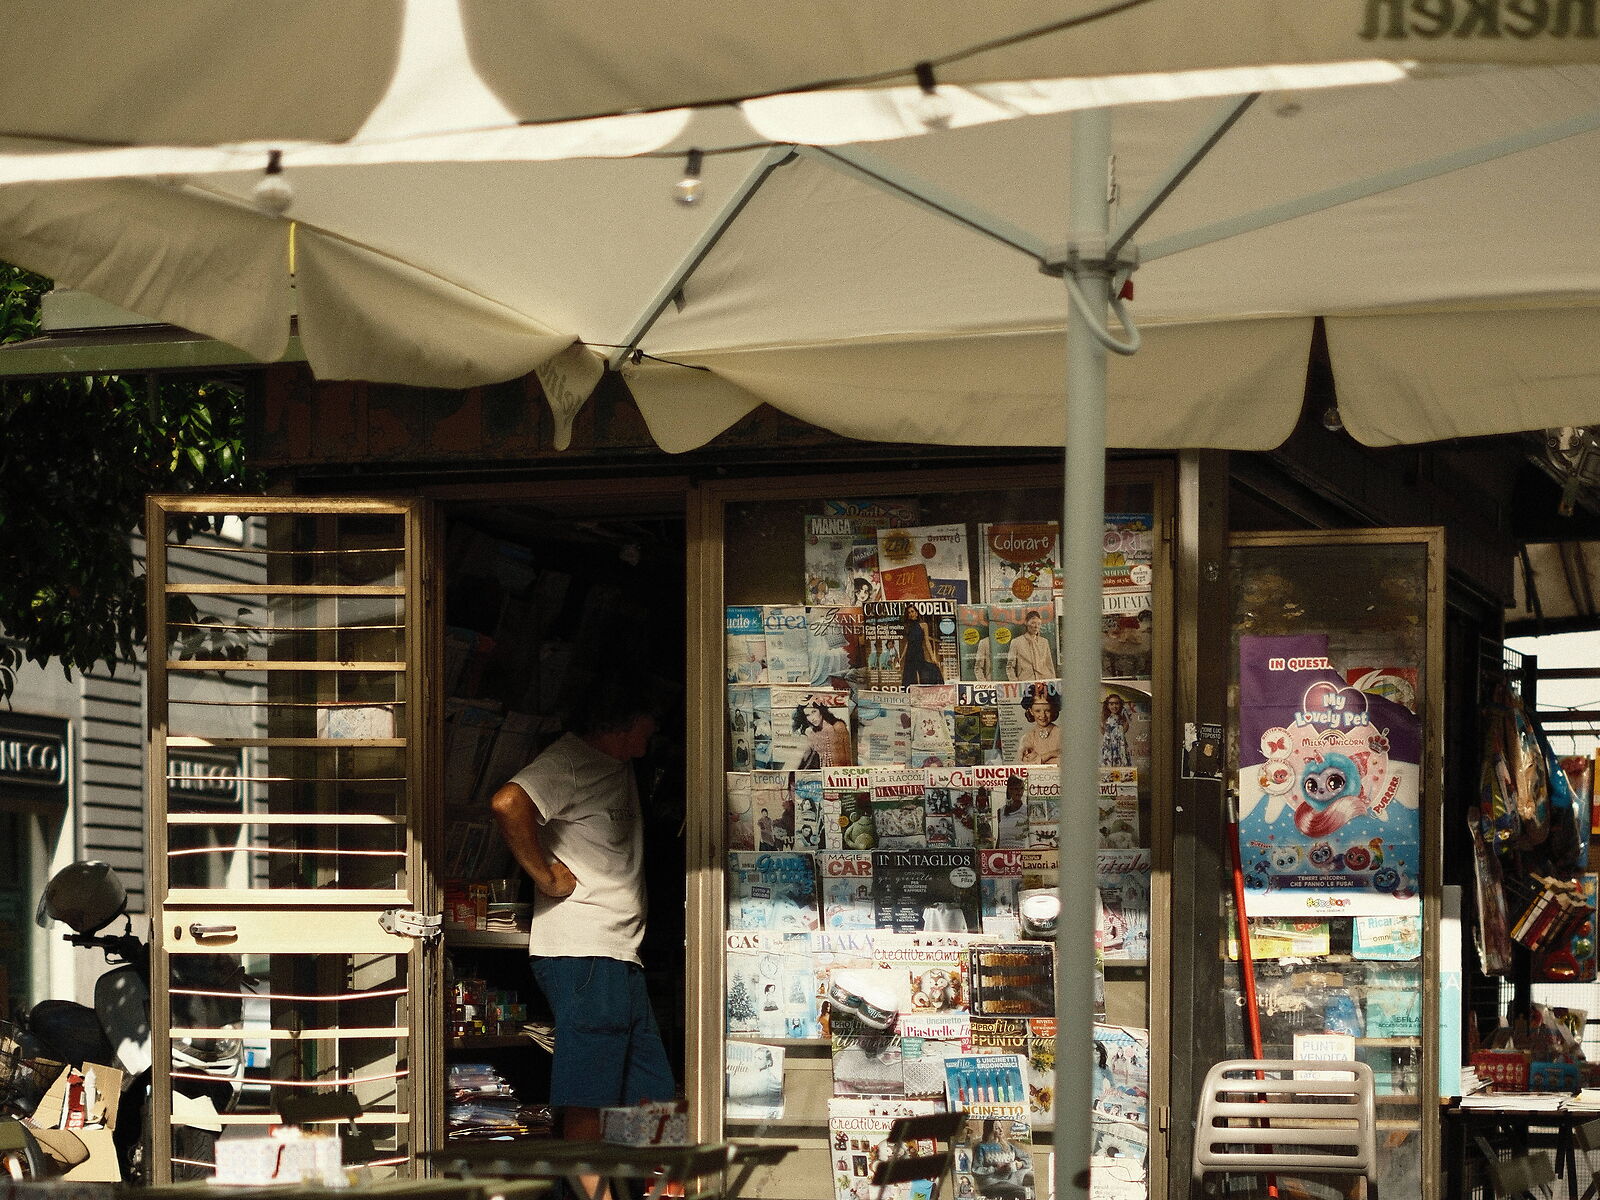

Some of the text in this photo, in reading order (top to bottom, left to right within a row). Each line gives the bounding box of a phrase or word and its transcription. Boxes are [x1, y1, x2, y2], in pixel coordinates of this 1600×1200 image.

[994, 530, 1049, 551] Colorare
[1270, 659, 1285, 670] IN
[1322, 693, 1346, 710] My
[1295, 711, 1369, 728] Lovely Pet
[754, 774, 787, 785] trendy
[828, 861, 872, 876] CAR
[1022, 860, 1048, 870] Lavori
[906, 1026, 955, 1037] Piastrelle
